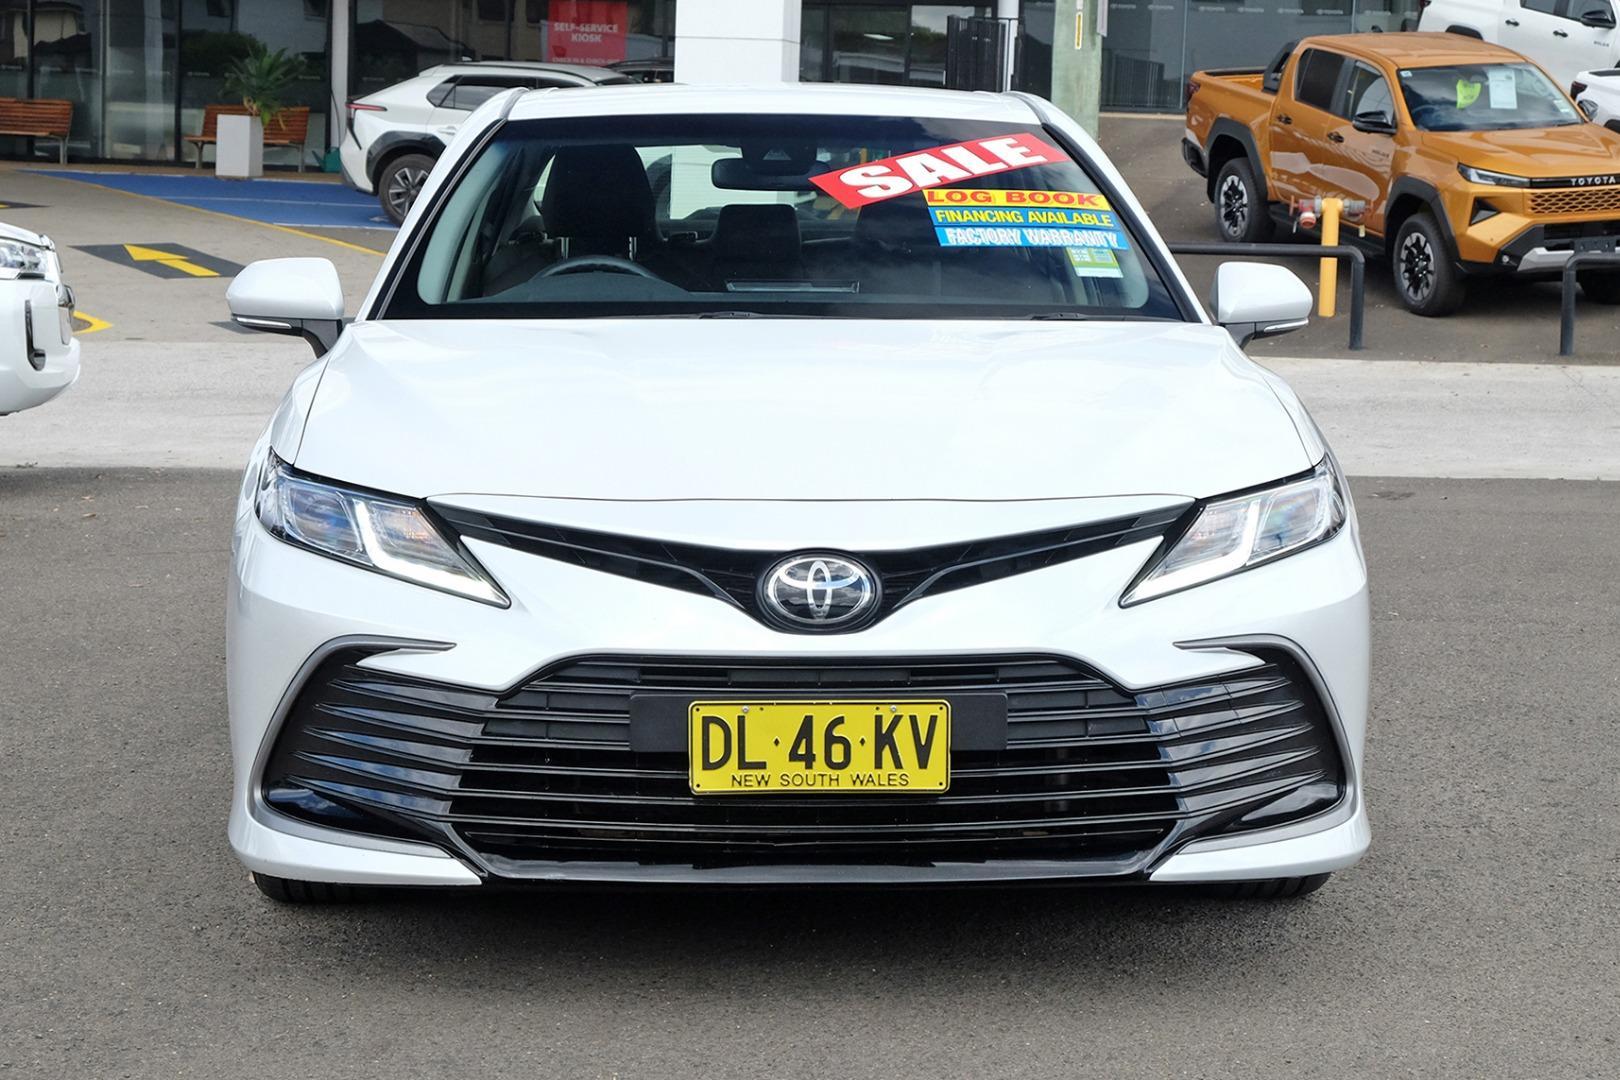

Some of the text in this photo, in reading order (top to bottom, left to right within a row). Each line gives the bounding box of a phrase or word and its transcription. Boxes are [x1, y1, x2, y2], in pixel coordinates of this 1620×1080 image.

[554, 22, 619, 33] SELF-SERVICE
[571, 33, 602, 42] KIOSK
[838, 136, 1047, 198] SALE
[1570, 176, 1616, 186] TOYOTA
[927, 190, 1099, 207] LOG BOOK
[935, 209, 1114, 227] FINANCING AVAILABLE
[945, 227, 1119, 248] FACTORY WARRANTY
[701, 714, 939, 771] DL 46 KV
[731, 773, 910, 787] NEW SOUTH WALES
